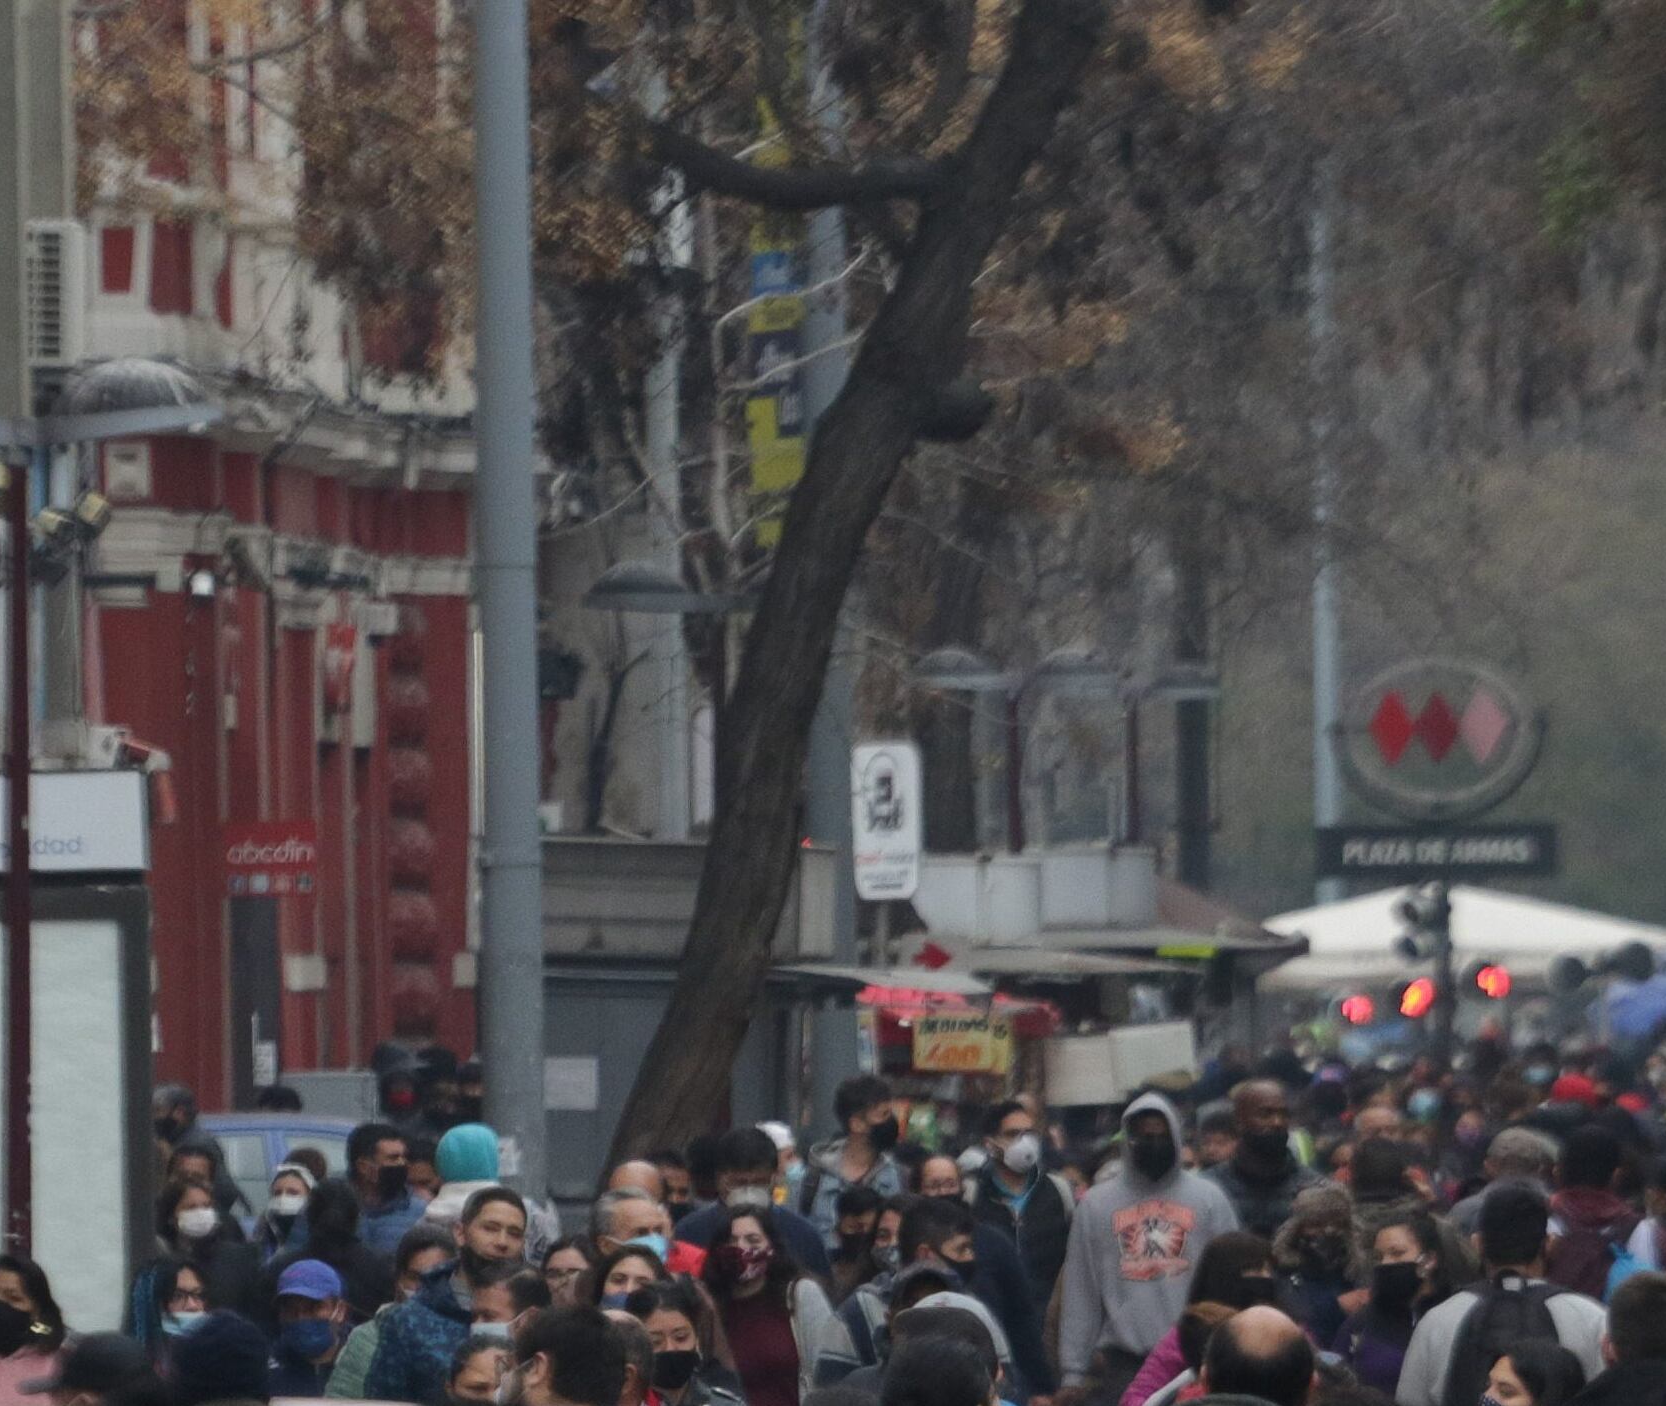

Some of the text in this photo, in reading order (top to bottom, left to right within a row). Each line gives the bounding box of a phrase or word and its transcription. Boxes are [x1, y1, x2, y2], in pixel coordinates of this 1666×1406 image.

[226, 838, 314, 864] abcdin
[1342, 838, 1530, 865] PLAZA DE ARMAS
